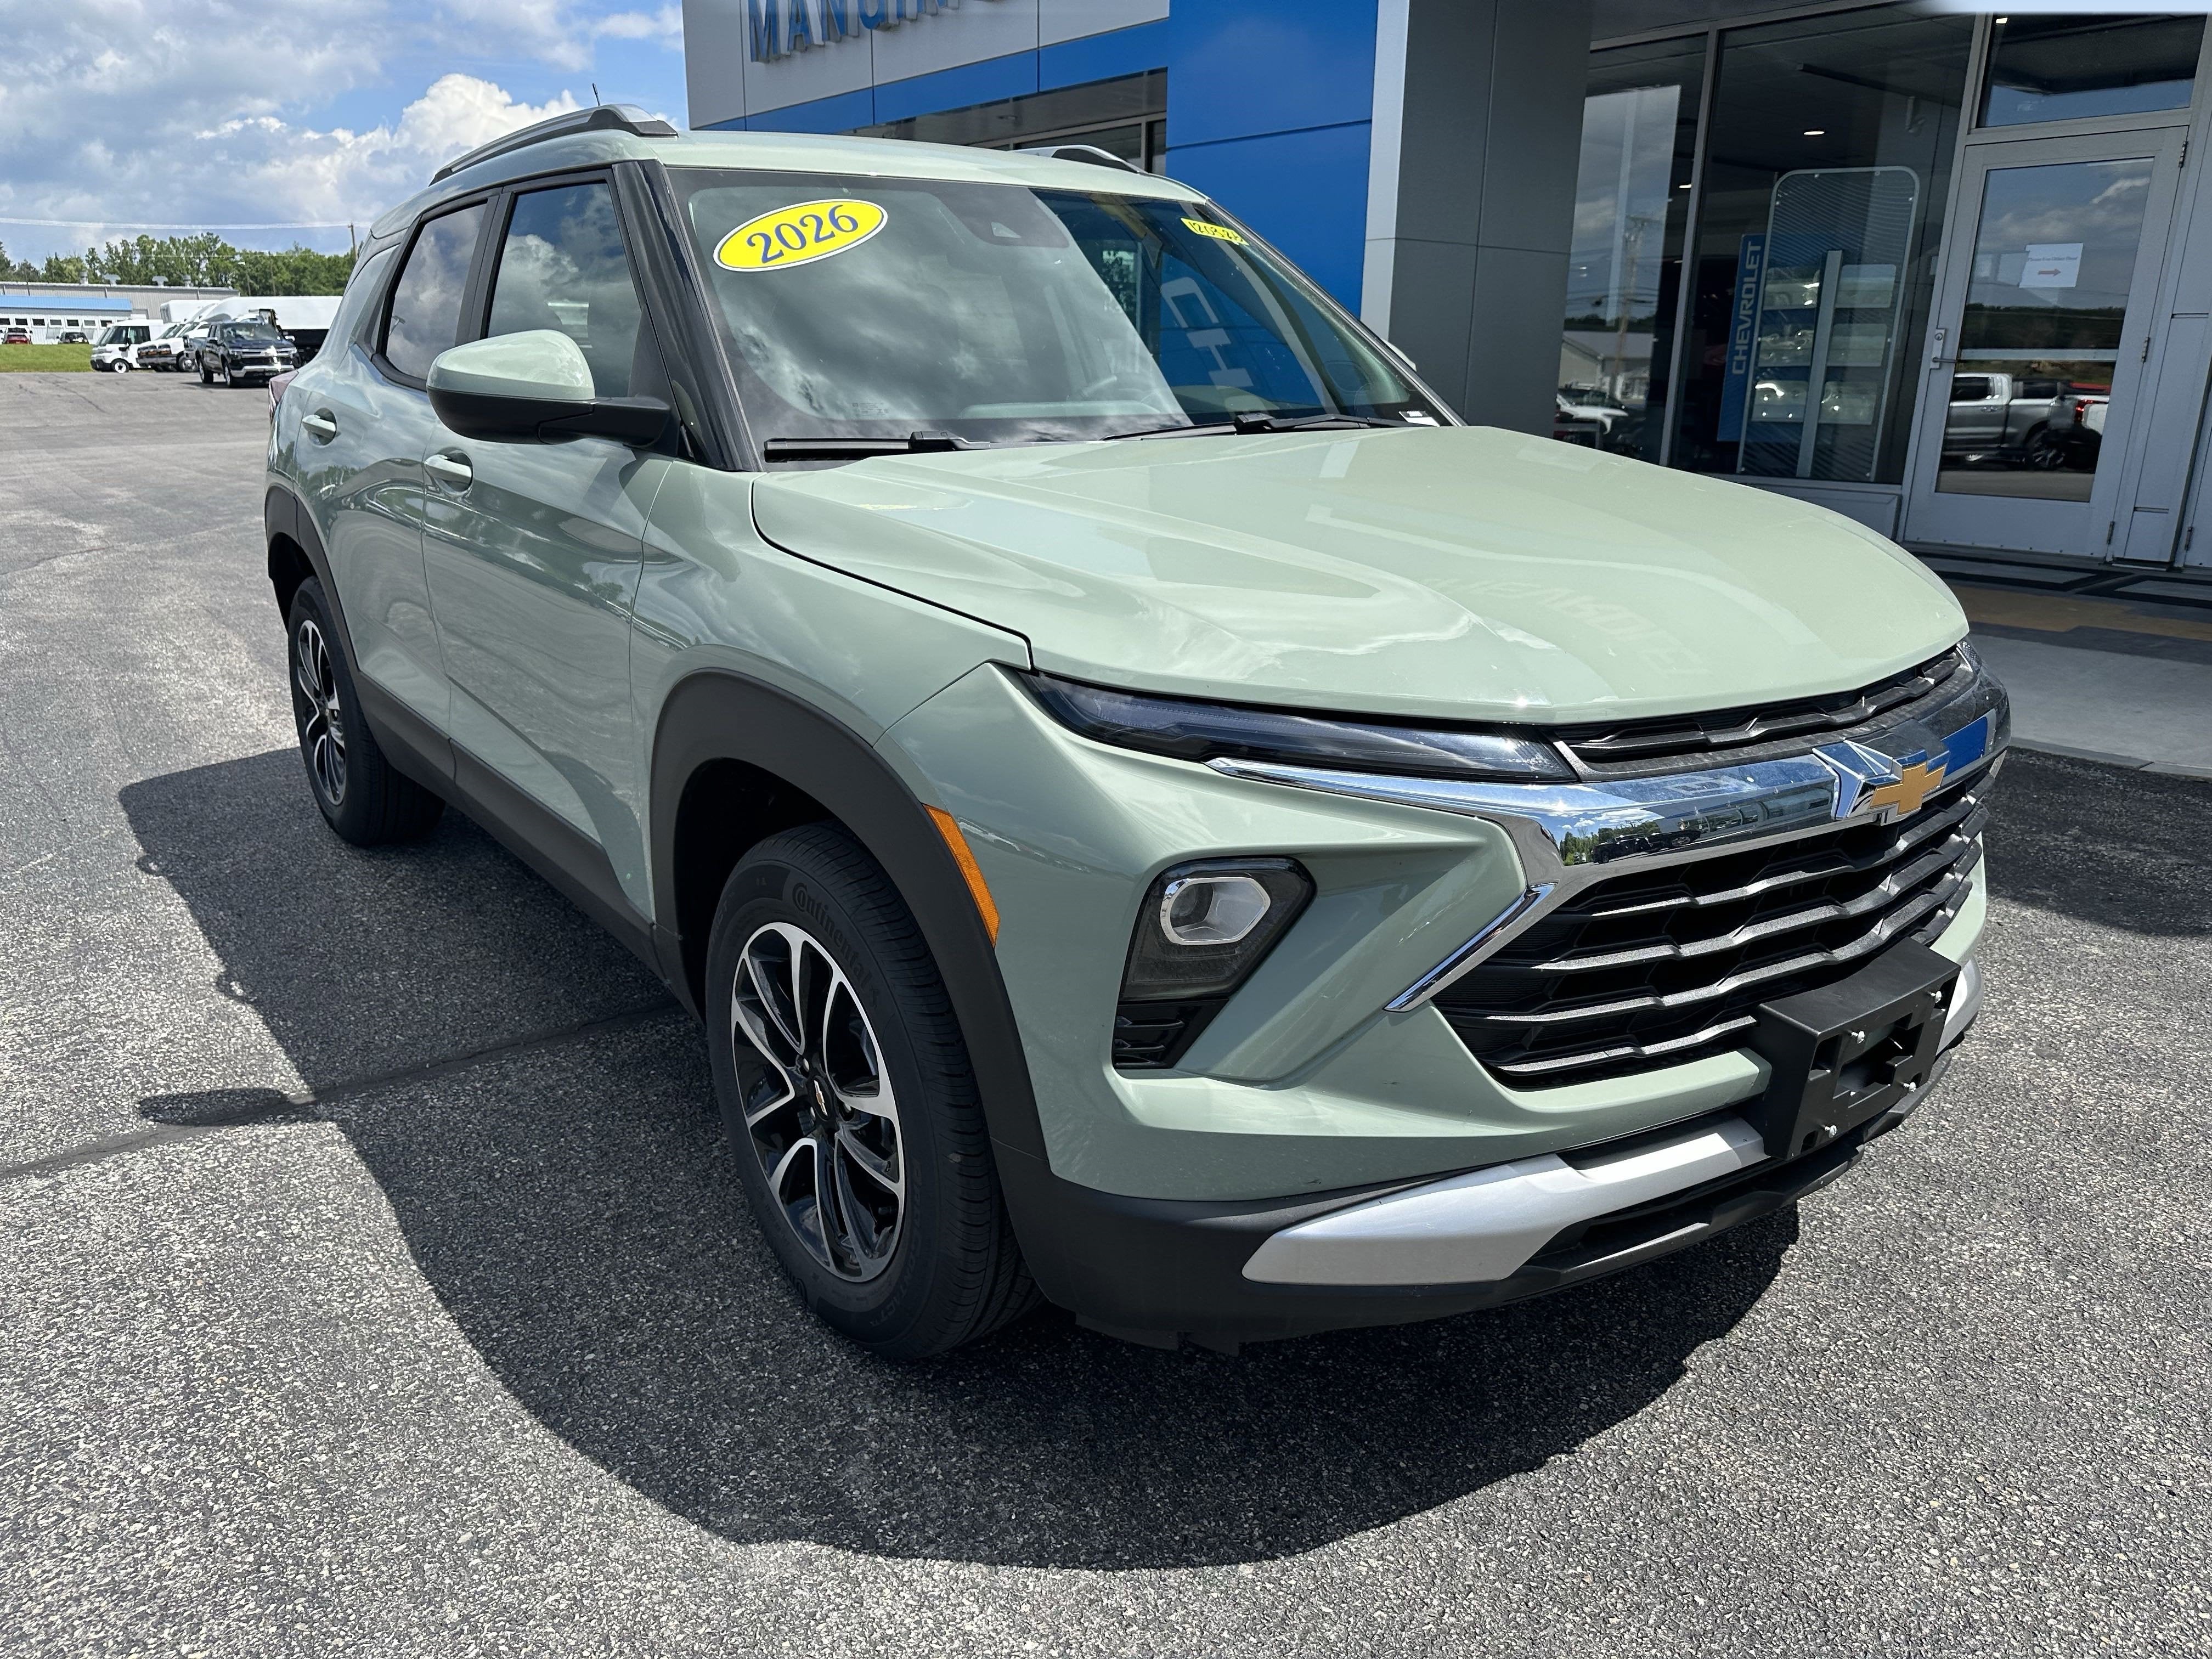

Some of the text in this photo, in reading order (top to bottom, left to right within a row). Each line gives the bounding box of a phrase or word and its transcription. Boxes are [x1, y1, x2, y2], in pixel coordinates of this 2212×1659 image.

[746, 204, 859, 264] 2026
[1731, 241, 1762, 375] CHEVROLET
[792, 882, 872, 991] Continental
